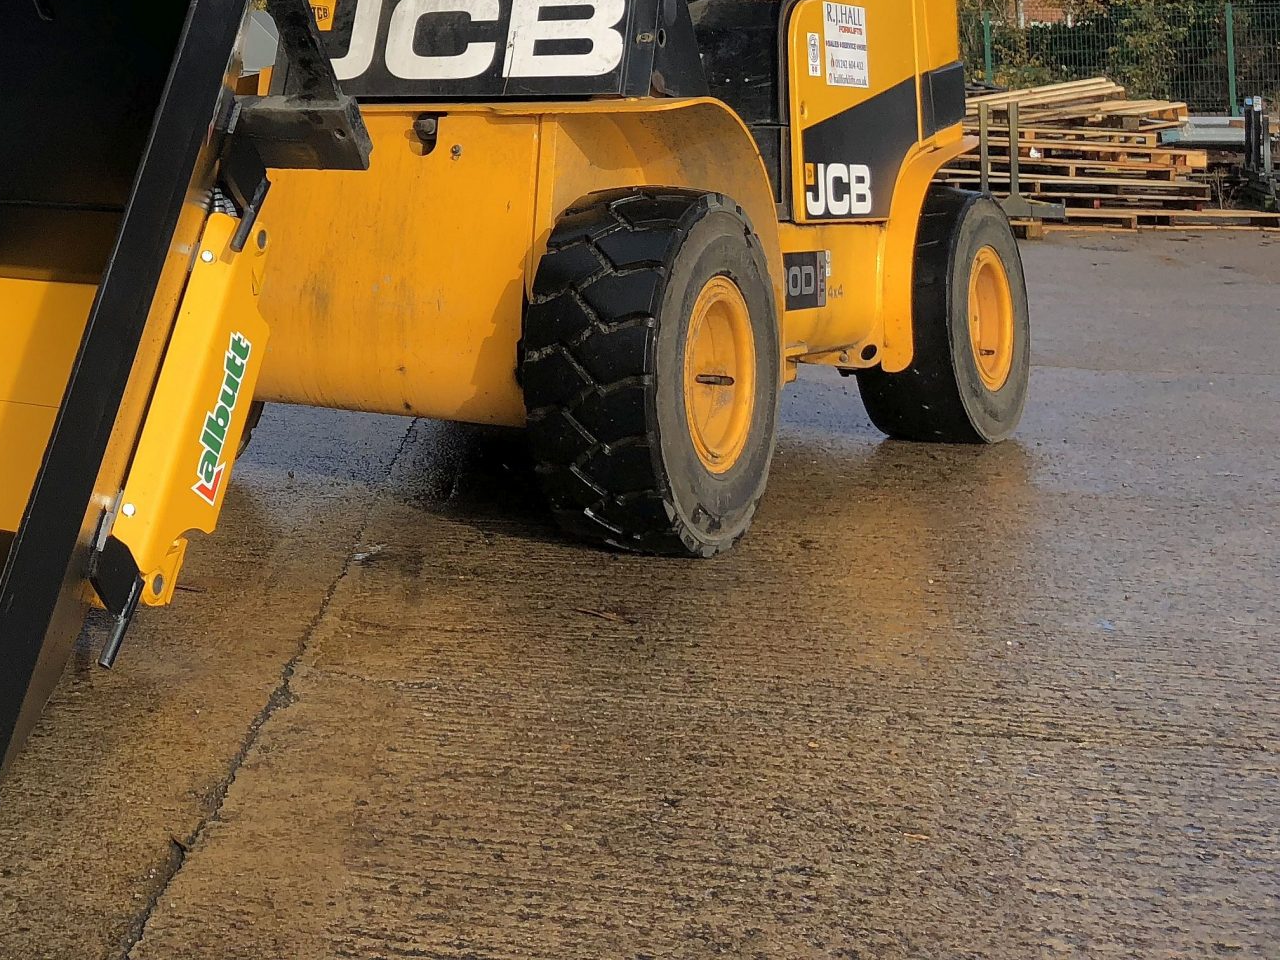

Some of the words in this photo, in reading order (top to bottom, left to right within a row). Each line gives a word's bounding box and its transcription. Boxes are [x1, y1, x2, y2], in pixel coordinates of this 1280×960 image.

[838, 25, 862, 35] FORKLIFTS
[806, 163, 872, 215] JCB
[784, 265, 814, 297] 0D
[197, 331, 251, 485] albutt
